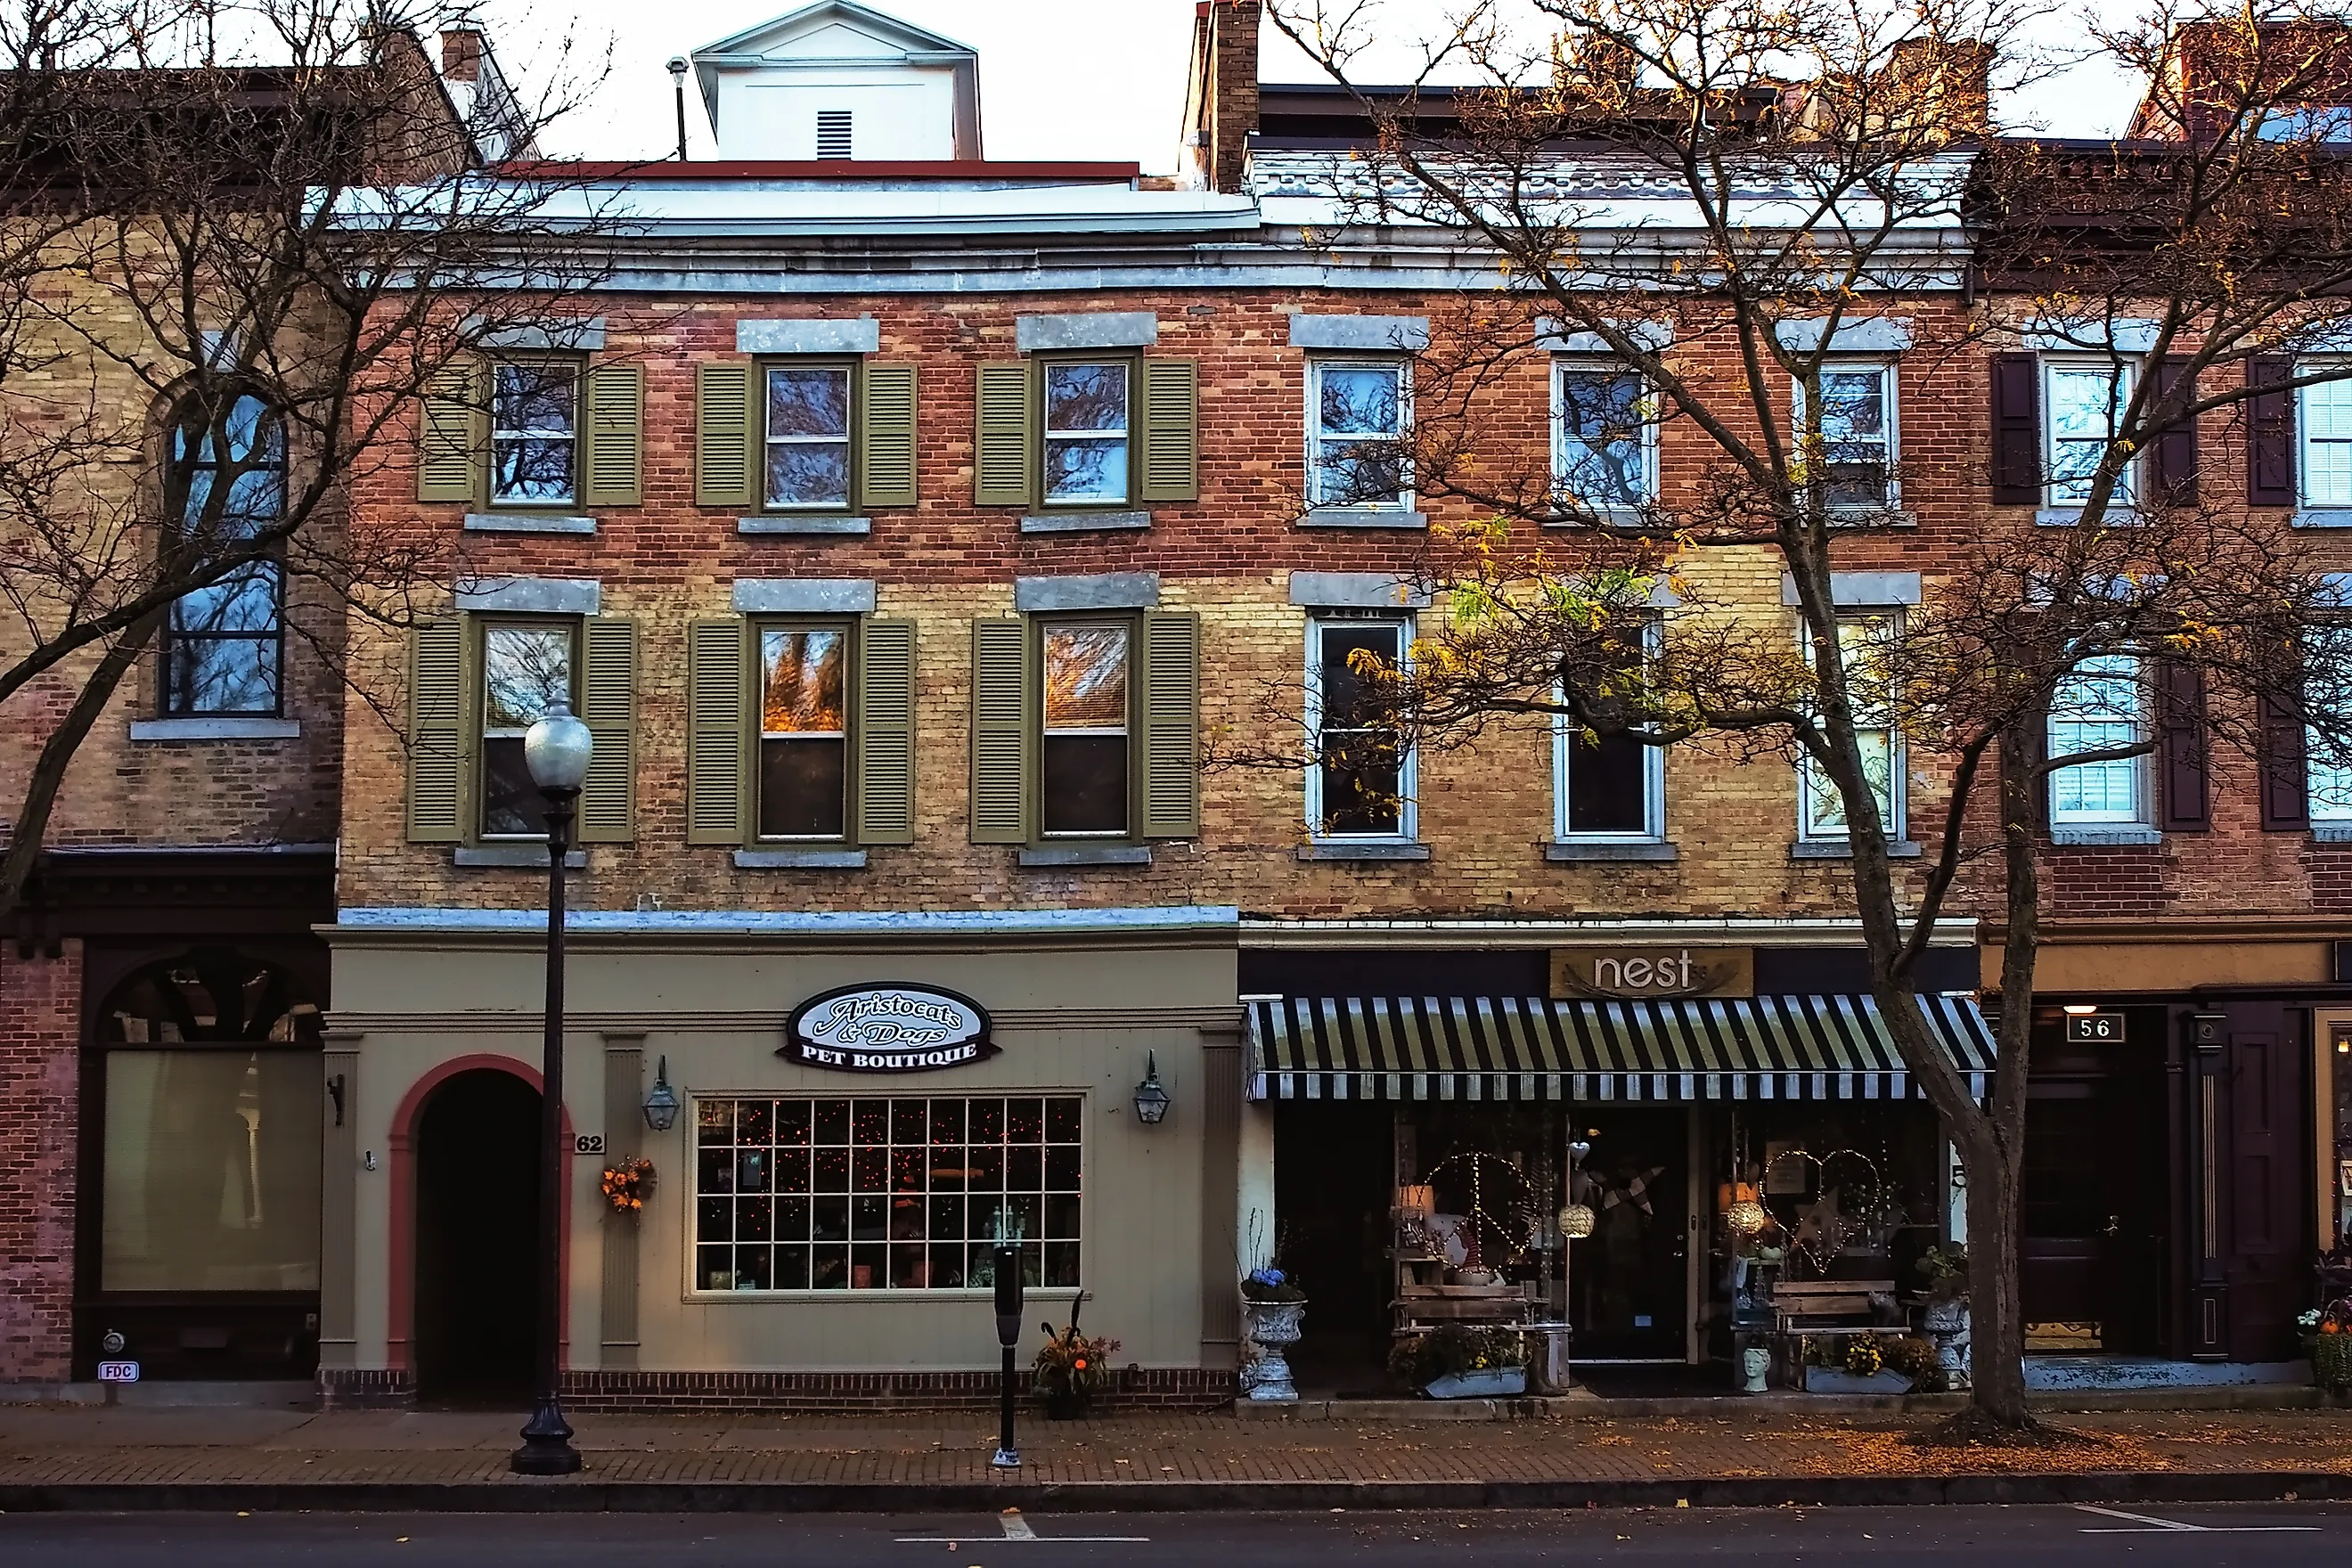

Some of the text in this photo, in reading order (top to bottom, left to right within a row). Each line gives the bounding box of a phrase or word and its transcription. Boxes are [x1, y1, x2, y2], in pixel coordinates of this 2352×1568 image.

[1595, 949, 1693, 988] nest
[813, 993, 962, 1036] Aristocats
[837, 1022, 948, 1046] & Dogs
[2080, 1019, 2110, 1037] 56
[802, 1043, 977, 1067] PET BOUTIQUE
[576, 1135, 603, 1152] 62
[106, 1365, 131, 1378] FDC
